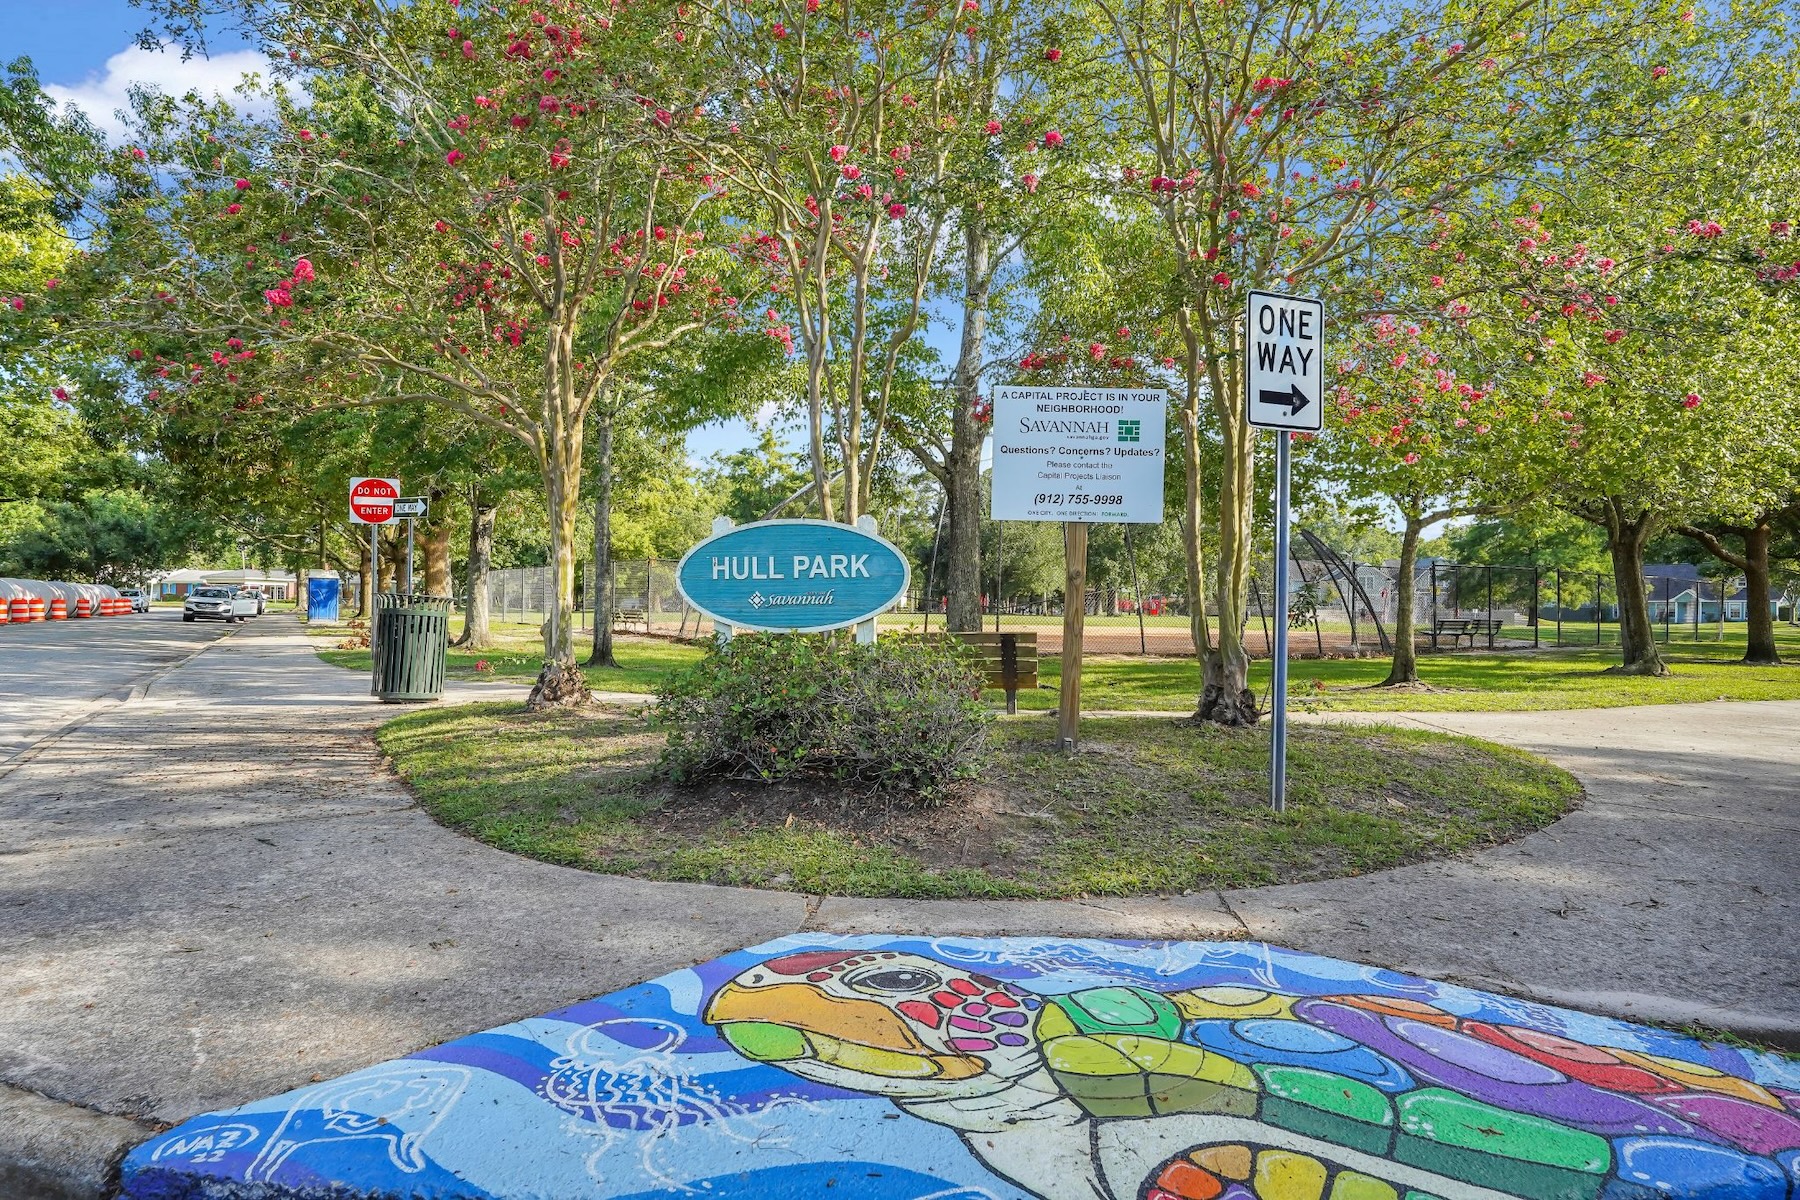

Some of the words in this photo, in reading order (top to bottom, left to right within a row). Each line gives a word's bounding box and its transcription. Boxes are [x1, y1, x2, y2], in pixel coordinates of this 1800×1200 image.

[1260, 304, 1312, 340] ONE
[1258, 342, 1314, 376] WAY
[1011, 392, 1053, 400] CAPITAL
[1057, 392, 1102, 400] PROJECT
[1037, 405, 1123, 413] NEIGHBORHOOD!
[1001, 445, 1055, 454] Questions?
[1059, 447, 1110, 455] Concerns?
[1114, 448, 1160, 457] Updates?
[1038, 472, 1062, 480] Capital
[1034, 494, 1064, 505] (912)
[1068, 494, 1122, 505] 755-9998
[396, 503, 406, 512] ONE
[408, 503, 418, 511] WAY
[712, 556, 784, 580] HULL
[793, 554, 870, 579] PARK
[765, 589, 834, 607] savannah
[189, 1149, 227, 1163] 22
